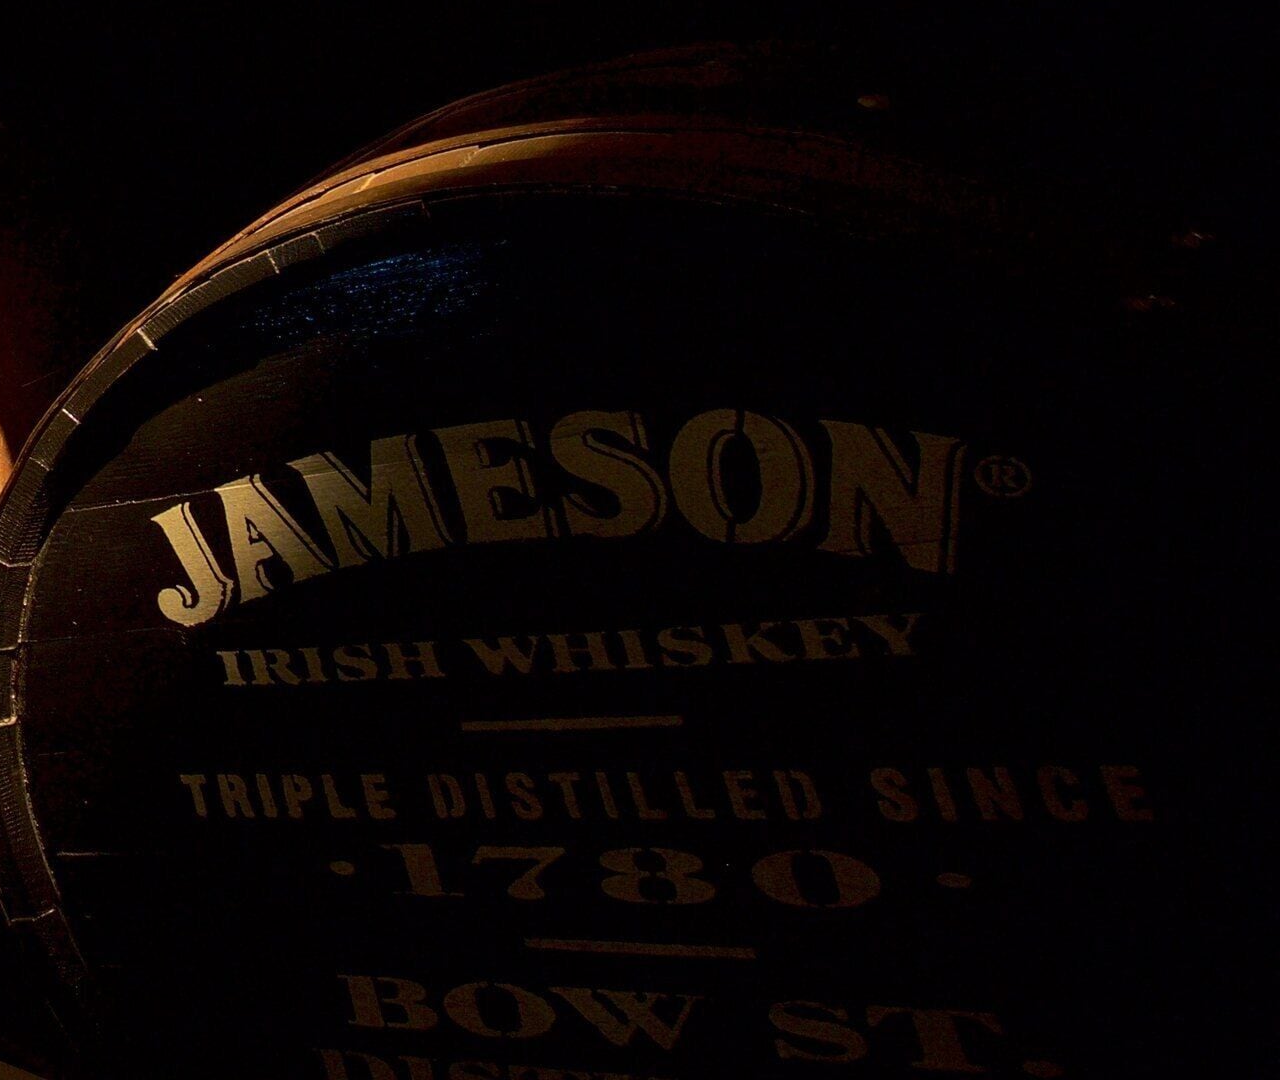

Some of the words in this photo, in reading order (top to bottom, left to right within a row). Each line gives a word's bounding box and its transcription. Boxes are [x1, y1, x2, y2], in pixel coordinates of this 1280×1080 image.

[216, 641, 446, 687] IRISH
[460, 610, 924, 678] WHISKEY
[179, 770, 397, 823] TRIPLE
[431, 768, 824, 824] DISTILLED
[871, 762, 1158, 826] SINCE
[337, 972, 706, 1052] BOW
